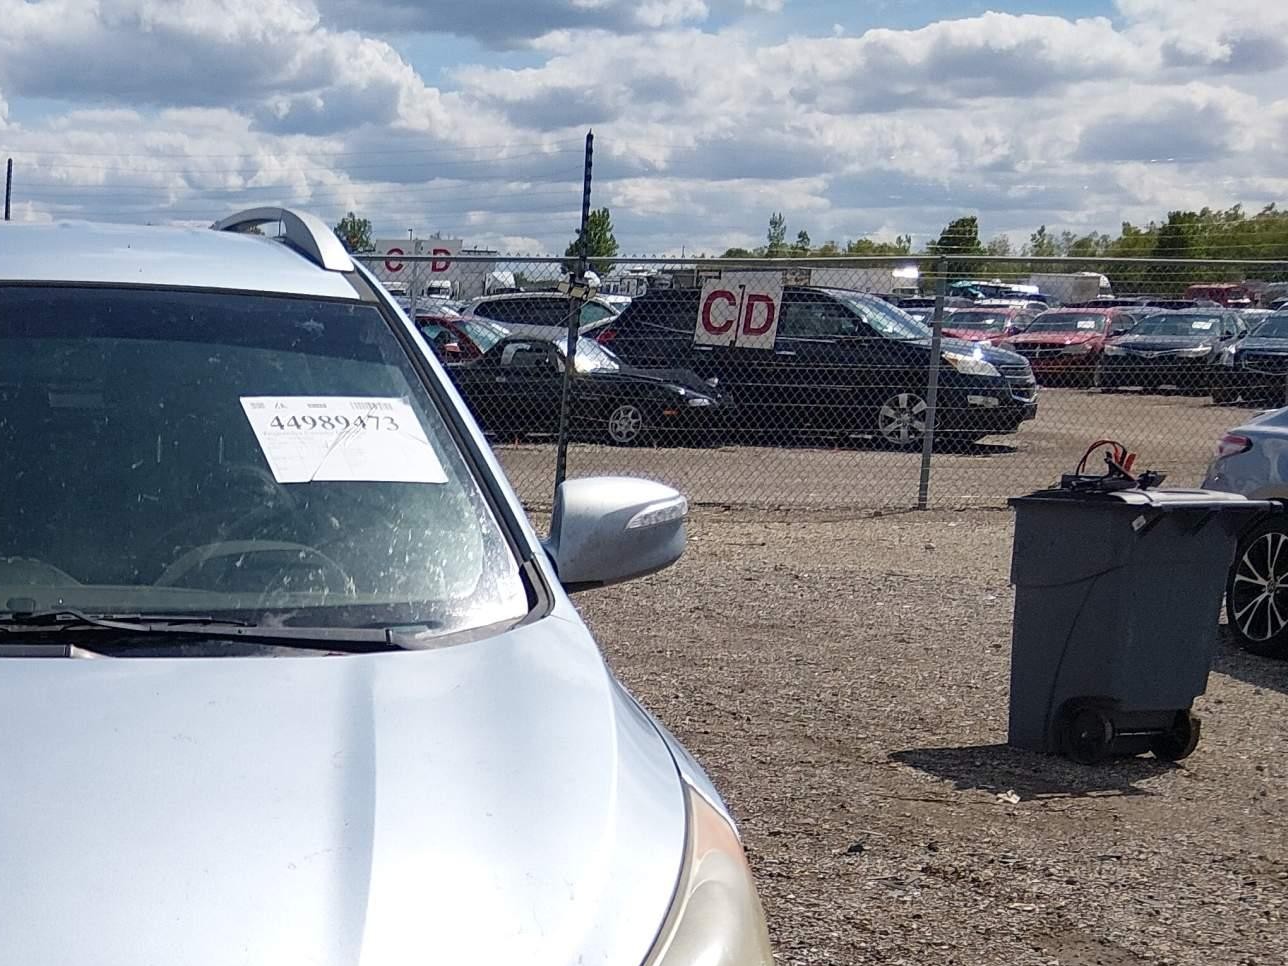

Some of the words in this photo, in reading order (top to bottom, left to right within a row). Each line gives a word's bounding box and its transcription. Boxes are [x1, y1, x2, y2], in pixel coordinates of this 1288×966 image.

[384, 247, 404, 272] C
[432, 248, 452, 272] D
[701, 289, 737, 335] C
[743, 293, 777, 335] D
[270, 415, 399, 431] 44989473
